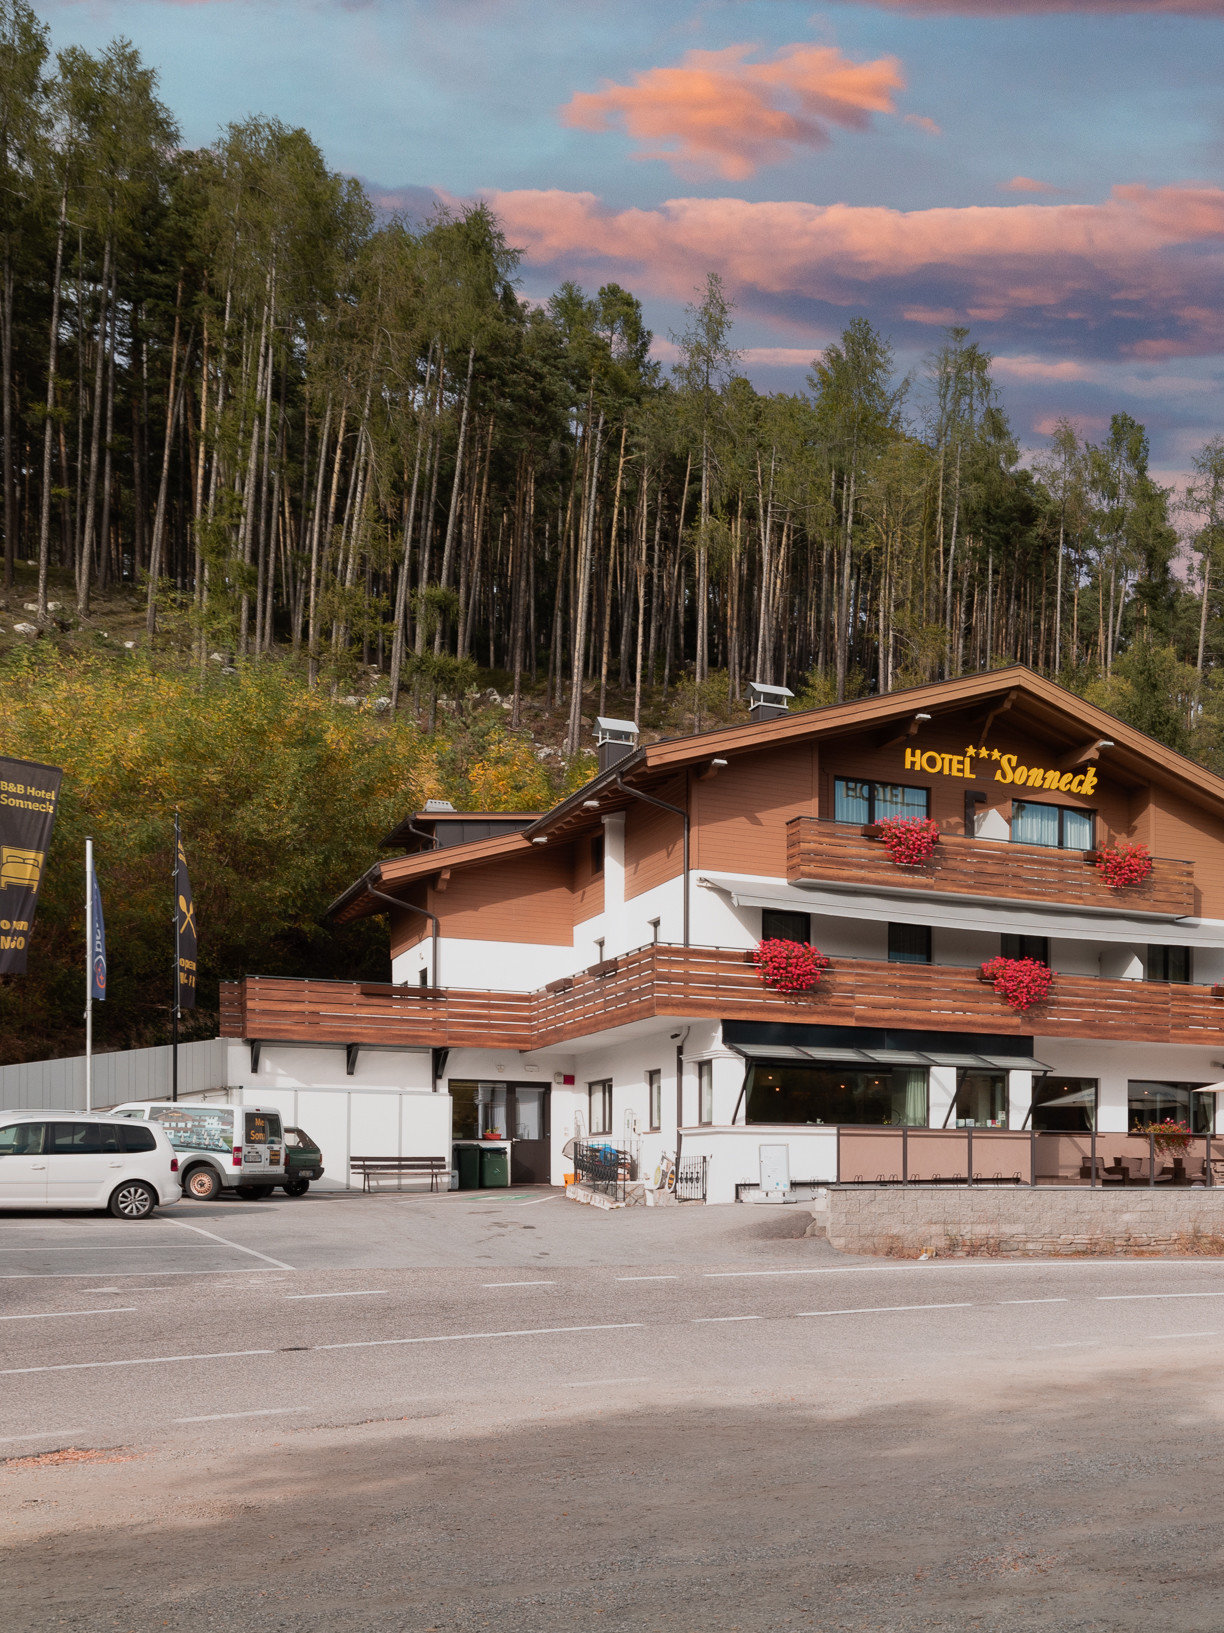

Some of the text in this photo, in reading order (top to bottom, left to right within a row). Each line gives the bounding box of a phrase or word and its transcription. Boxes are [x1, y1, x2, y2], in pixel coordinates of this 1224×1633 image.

[904, 747, 1098, 796] HOTEL Sonneck
[0, 780, 56, 800] B&B Hotel
[0, 794, 54, 813] Sonneck
